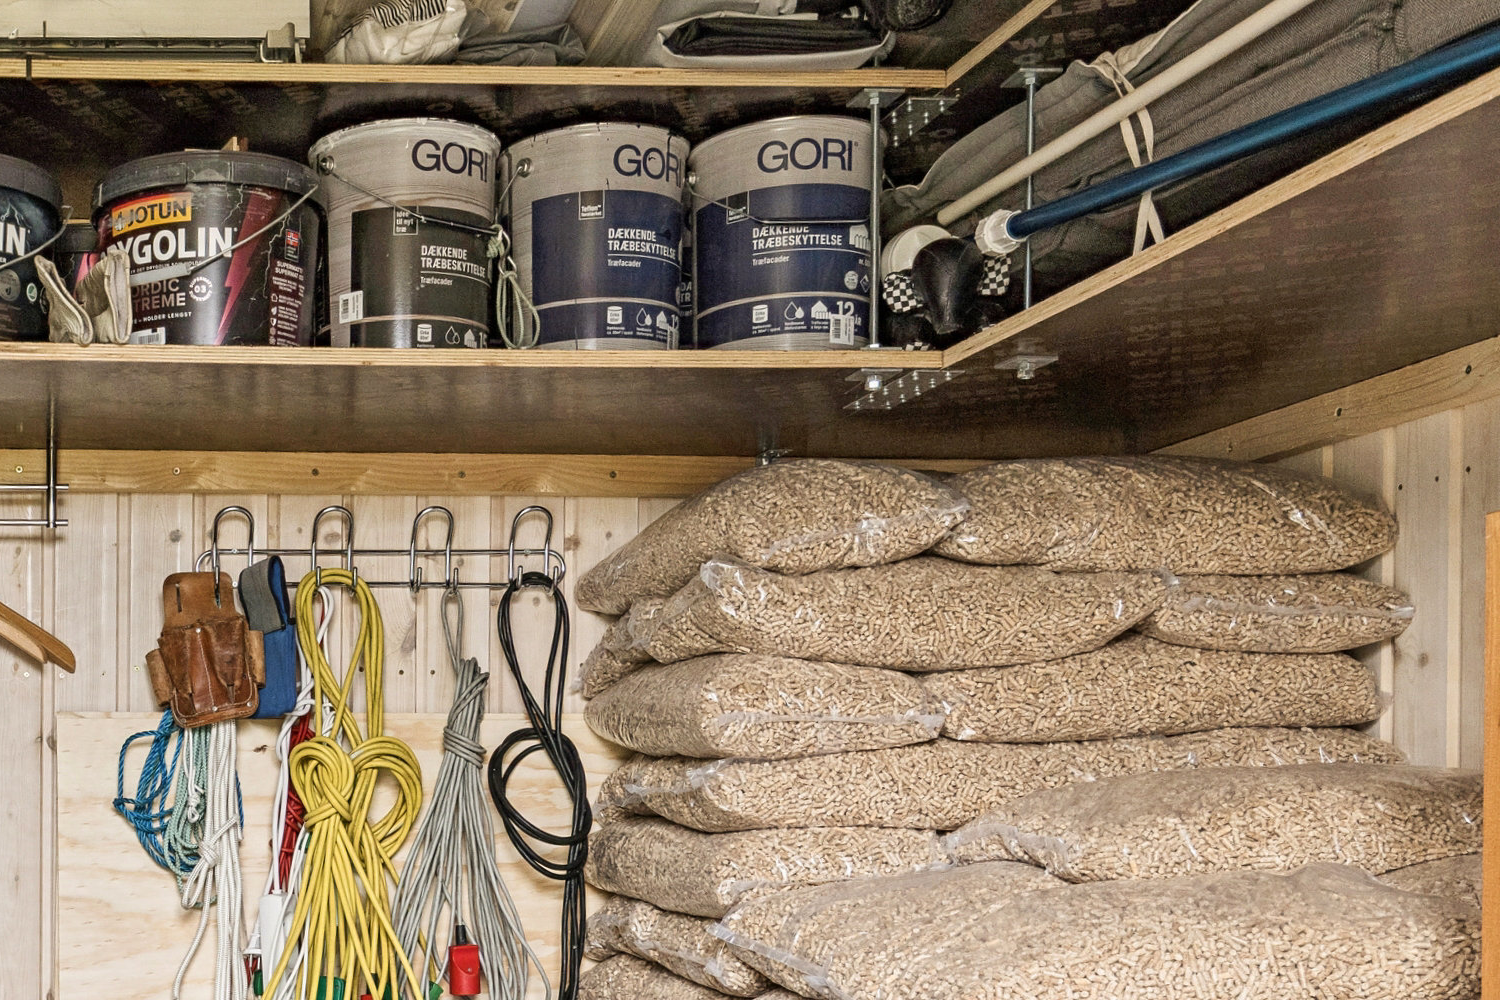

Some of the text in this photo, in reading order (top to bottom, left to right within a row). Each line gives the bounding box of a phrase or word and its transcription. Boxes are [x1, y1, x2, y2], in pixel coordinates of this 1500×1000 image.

[411, 139, 487, 183] GORI
[613, 144, 682, 186] GORI
[756, 137, 854, 174] GORI
[127, 200, 187, 227] JOTUN
[608, 228, 657, 242] DÆKKENDE
[752, 234, 843, 250] TRÆBESKYTTELSE
[753, 226, 810, 239] DÆKKENDE
[103, 227, 233, 265] YGOLIN
[421, 245, 468, 260] DÆKKENDE
[608, 240, 676, 260] TRÆBESKYTTELSE
[421, 258, 486, 279] TRÆBESKYTTELSE
[133, 292, 186, 313] TREME
